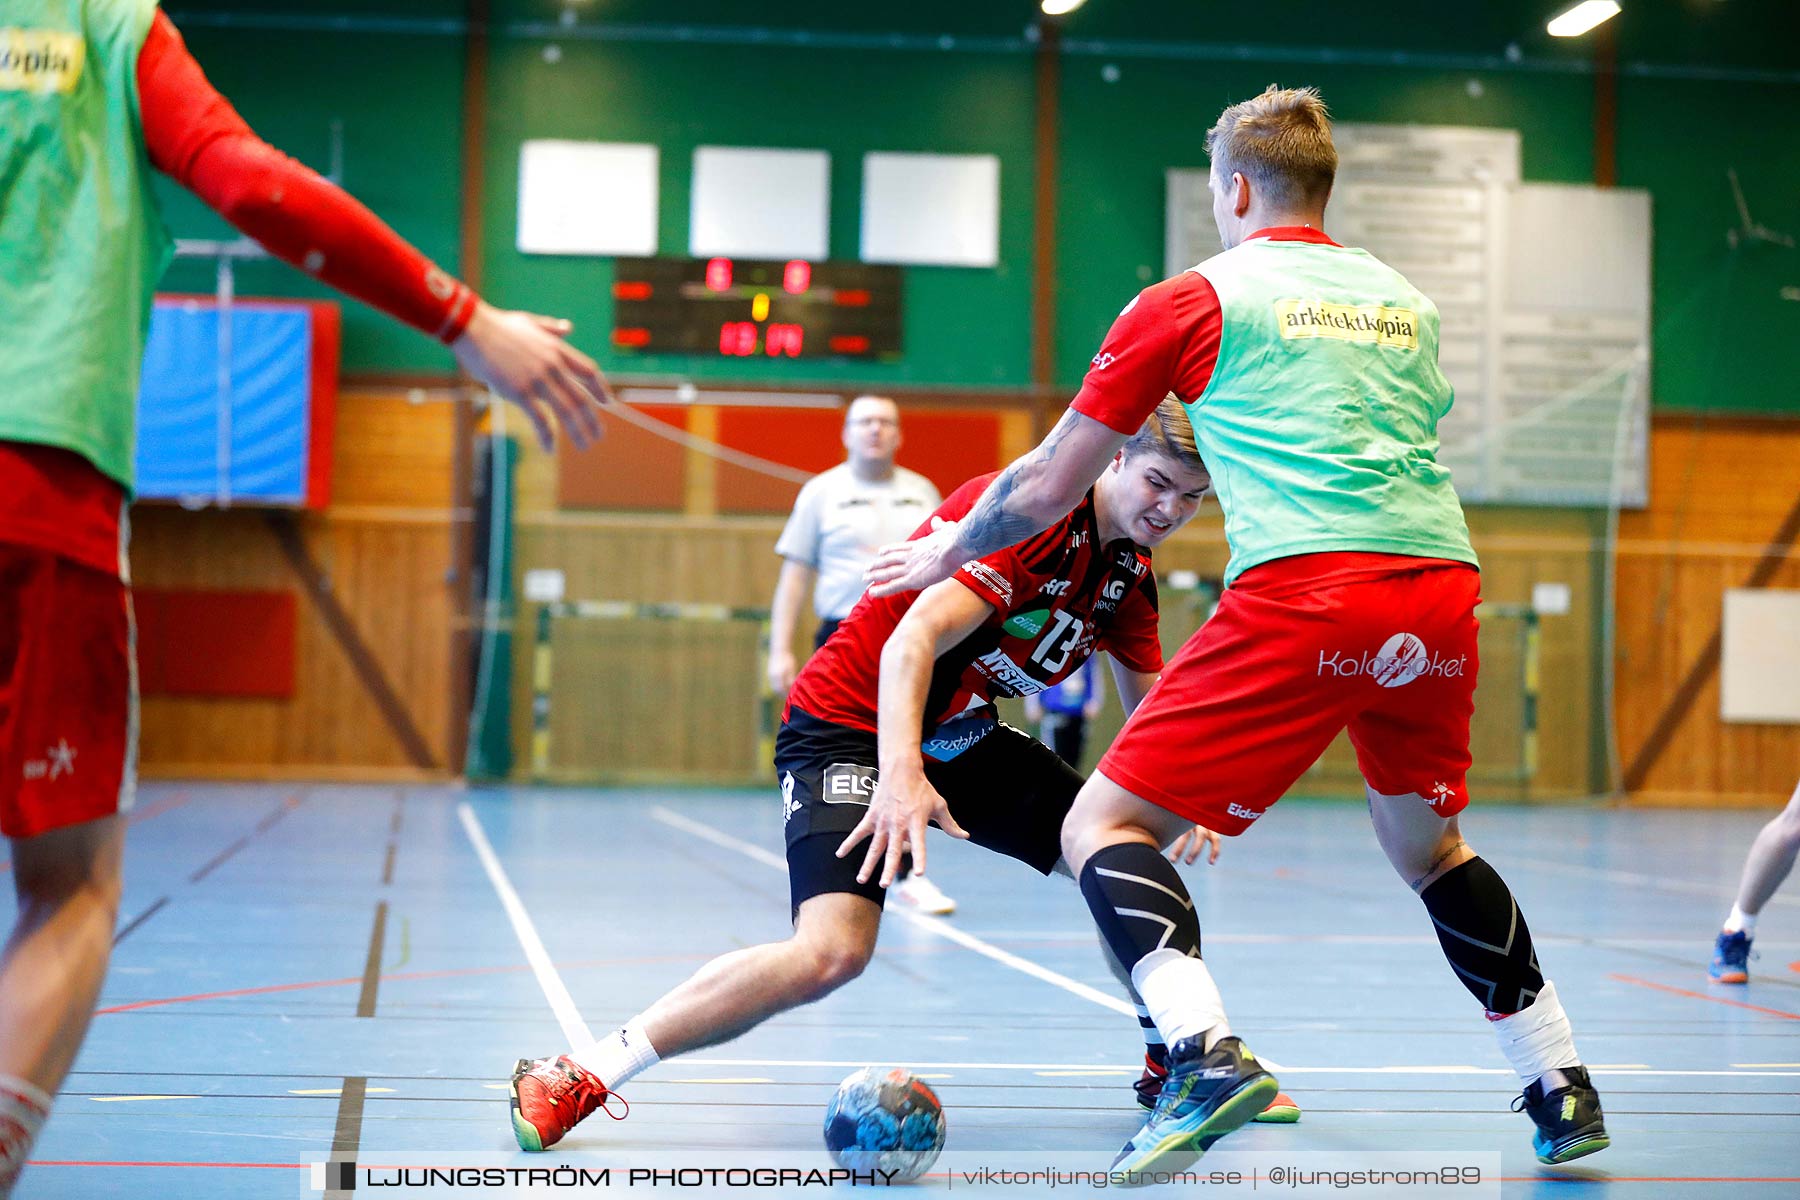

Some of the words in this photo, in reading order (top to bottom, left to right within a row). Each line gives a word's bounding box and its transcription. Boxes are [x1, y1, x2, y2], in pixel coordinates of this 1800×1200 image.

[0, 44, 70, 77] opia
[1286, 307, 1413, 338] arkitektkopia
[1031, 608, 1084, 674] 13
